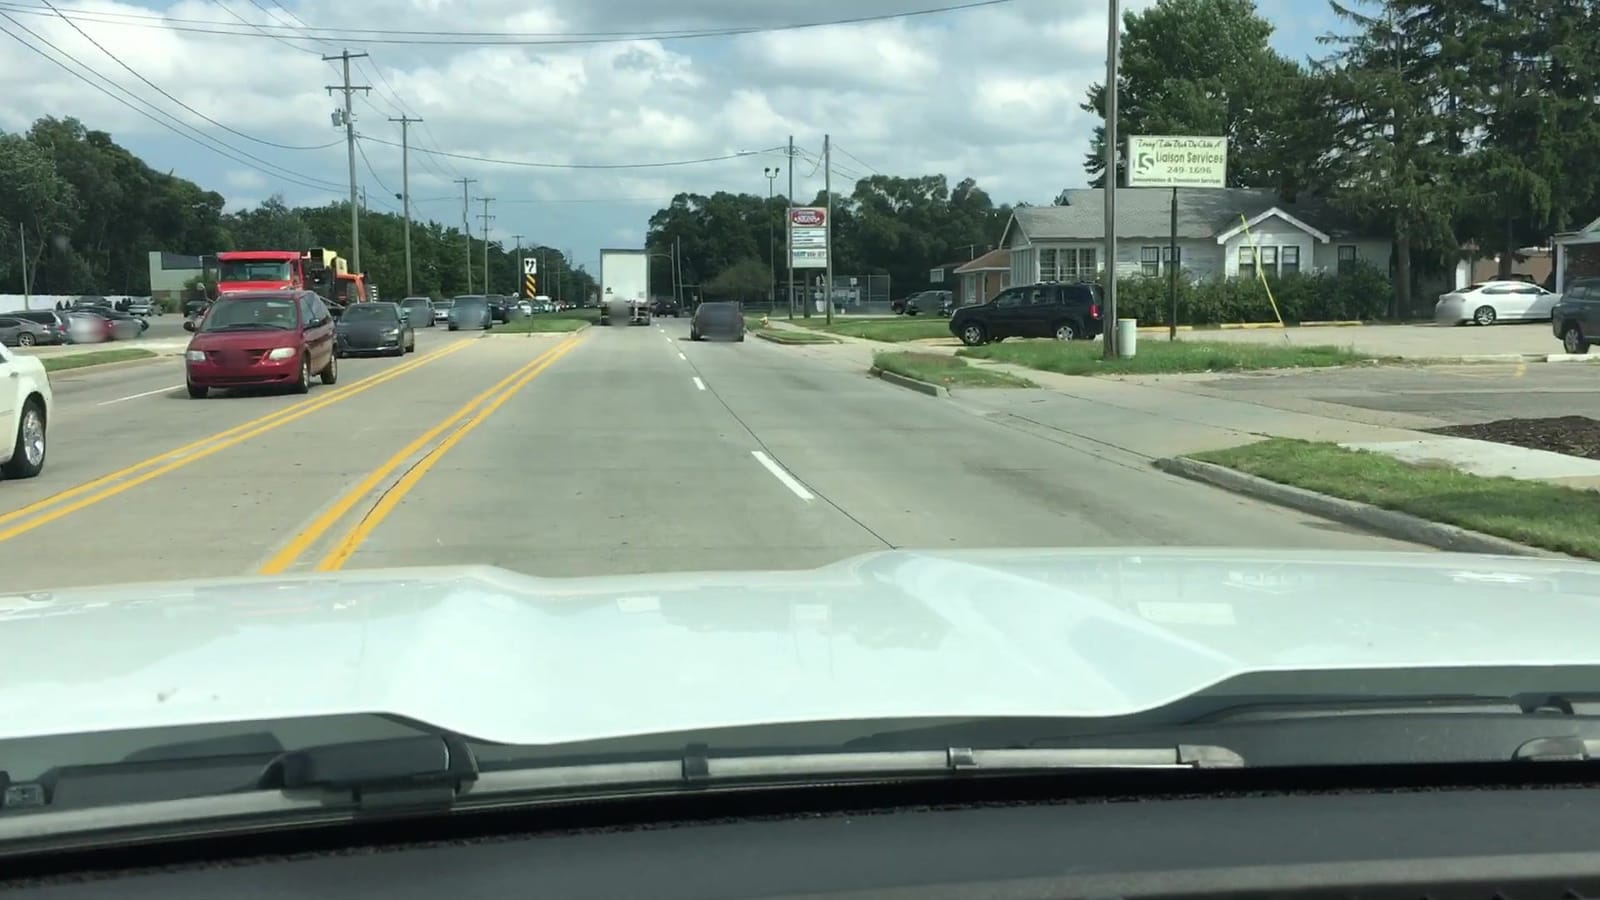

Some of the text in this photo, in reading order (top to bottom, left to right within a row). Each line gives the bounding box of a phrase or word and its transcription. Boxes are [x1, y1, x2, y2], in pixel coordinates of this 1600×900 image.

[1156, 152, 1223, 164] Liaison Services
[1167, 166, 1212, 174] 249-1696
